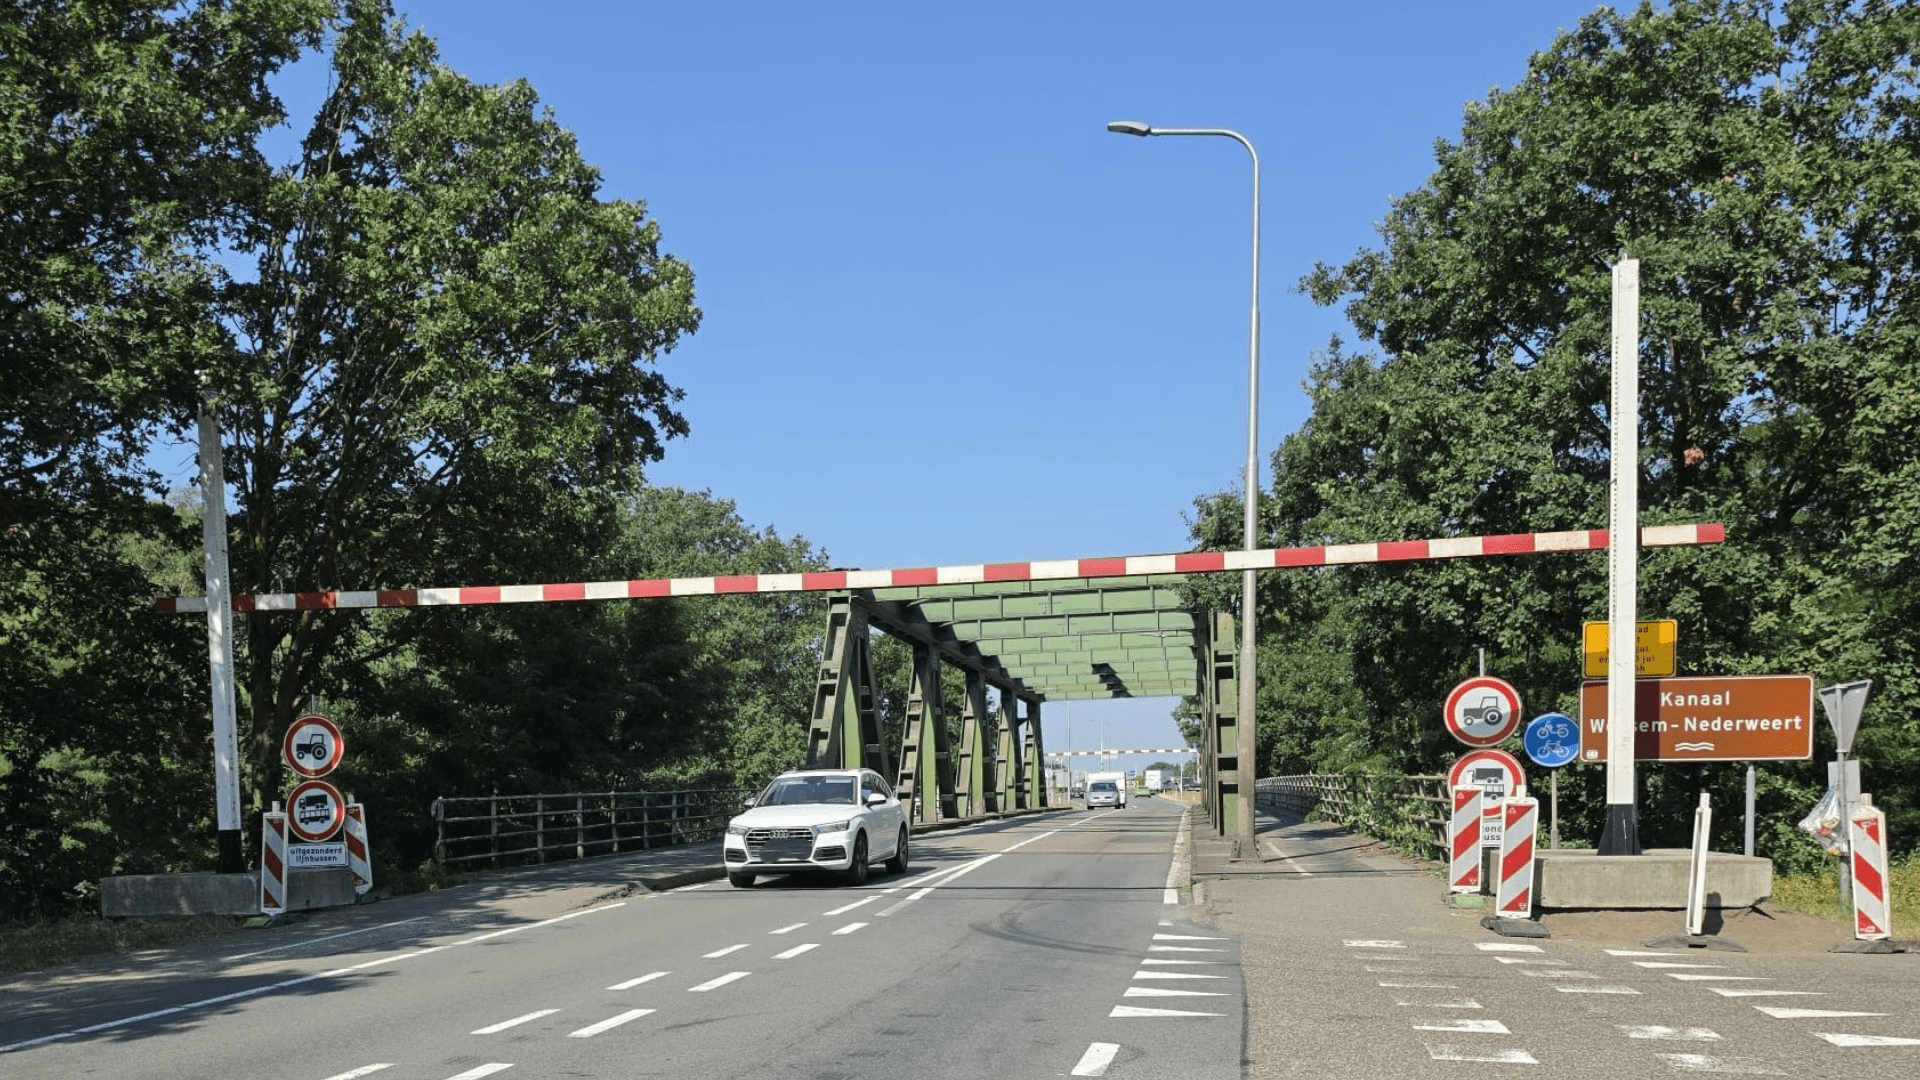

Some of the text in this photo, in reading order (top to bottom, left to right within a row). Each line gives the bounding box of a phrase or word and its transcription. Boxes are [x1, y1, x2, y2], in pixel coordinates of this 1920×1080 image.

[1660, 690, 1731, 707] Kanaal
[290, 847, 342, 855] uitgezonderd
[295, 855, 337, 863] lijnbussen
